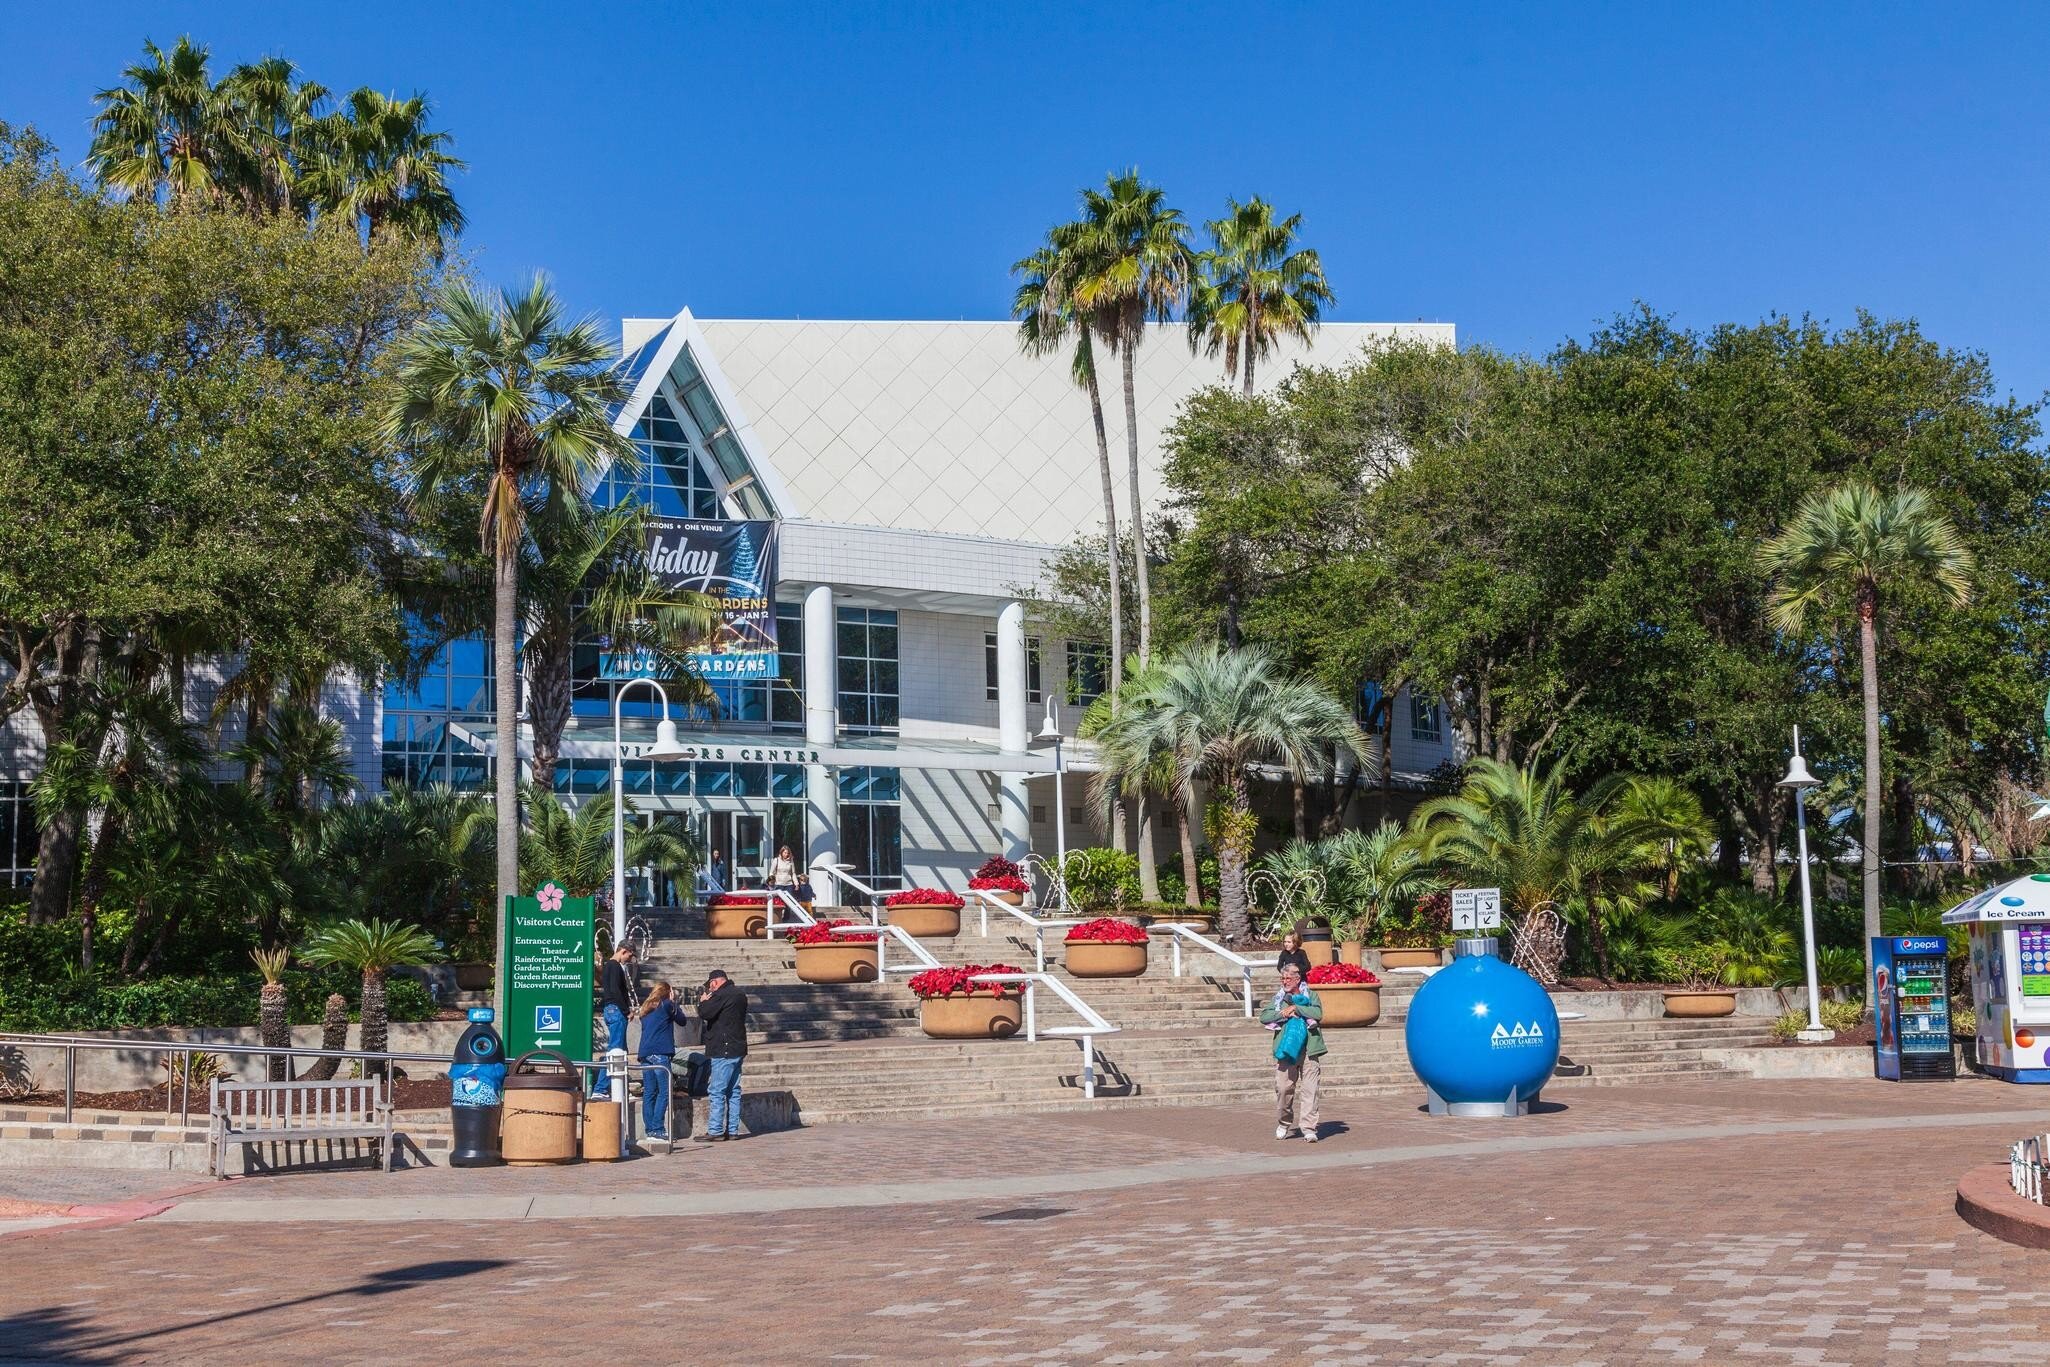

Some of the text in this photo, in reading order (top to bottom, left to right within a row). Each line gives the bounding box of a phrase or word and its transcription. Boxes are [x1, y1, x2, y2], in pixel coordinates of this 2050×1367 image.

[700, 524, 723, 532] VENUE
[709, 587, 730, 595] IN THE
[725, 611, 734, 619] 16
[742, 611, 760, 619] JAN
[761, 611, 769, 619] 12
[741, 749, 820, 764] CENTER
[2007, 910, 2045, 918] Cream
[515, 917, 585, 927] Visitors Center
[515, 936, 551, 945] Entrance
[1913, 940, 1939, 950] pepsi
[541, 947, 570, 955] Theater
[514, 955, 584, 964] Rainforest Pyramid
[542, 964, 566, 973] Lobby
[513, 972, 541, 980] Garden
[514, 981, 583, 990] Discovery Pyramid
[1491, 1037, 1517, 1046] MOODY
